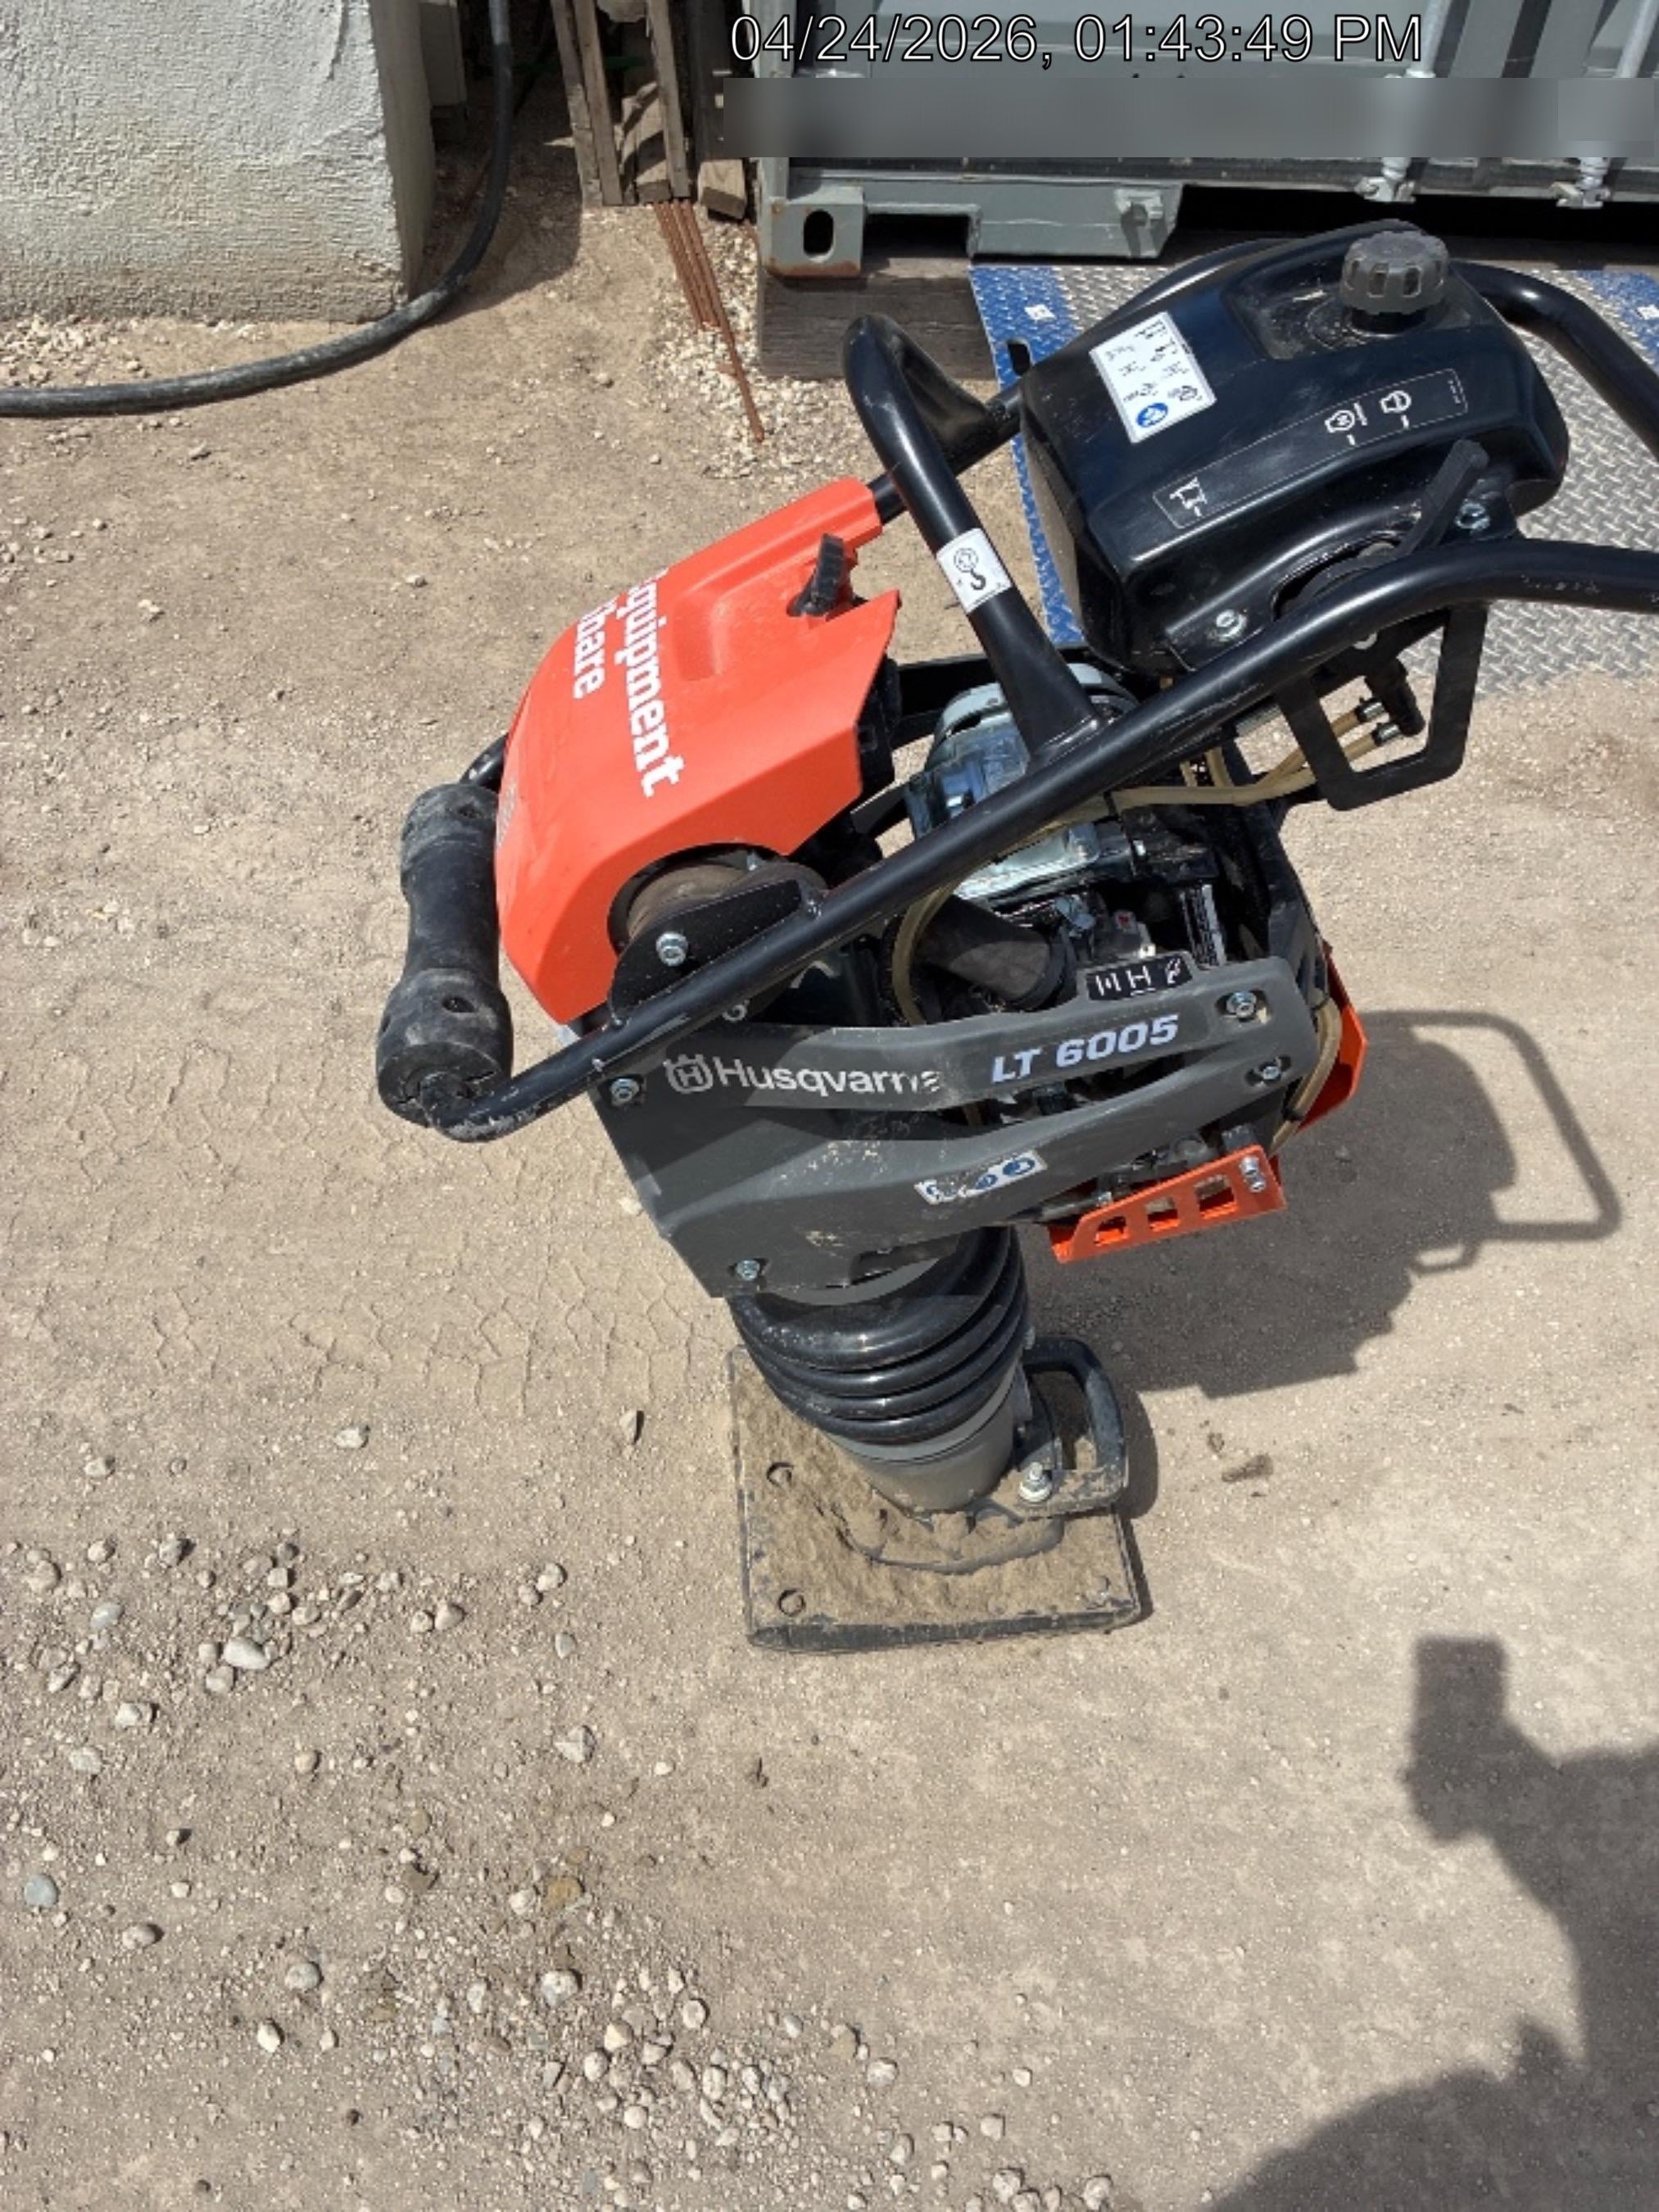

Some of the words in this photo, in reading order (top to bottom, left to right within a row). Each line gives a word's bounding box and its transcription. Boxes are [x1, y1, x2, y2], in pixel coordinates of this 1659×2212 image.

[573, 596, 617, 699] hare
[613, 567, 685, 798] quipment
[992, 1047, 1042, 1083] LT
[1055, 1013, 1180, 1067] 6005
